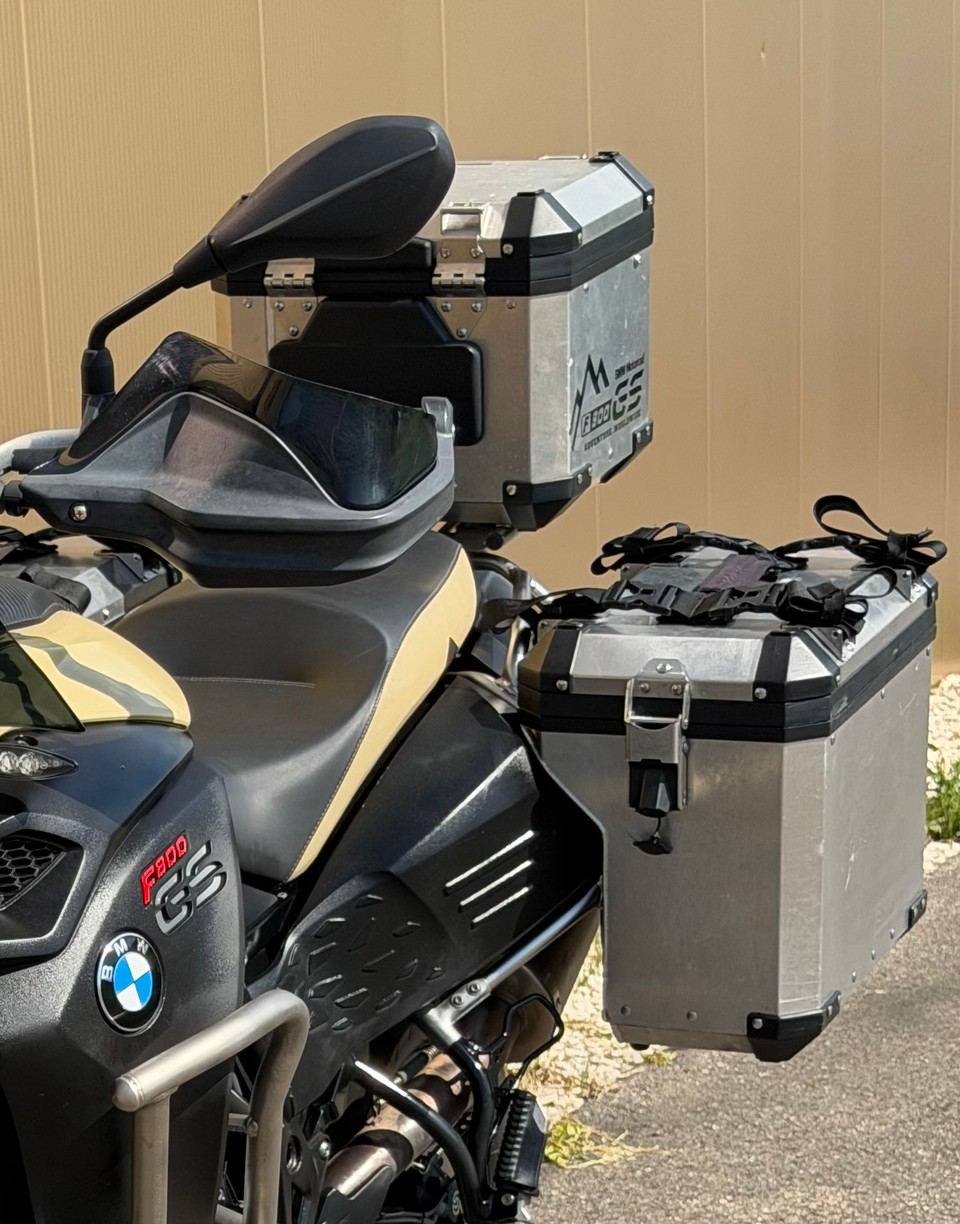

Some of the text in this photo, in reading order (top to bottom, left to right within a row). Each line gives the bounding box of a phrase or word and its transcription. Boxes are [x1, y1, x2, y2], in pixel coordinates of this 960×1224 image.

[613, 368, 644, 421] GS
[141, 833, 188, 906] F800
[154, 840, 227, 935] GS
[101, 938, 148, 983] BMW
